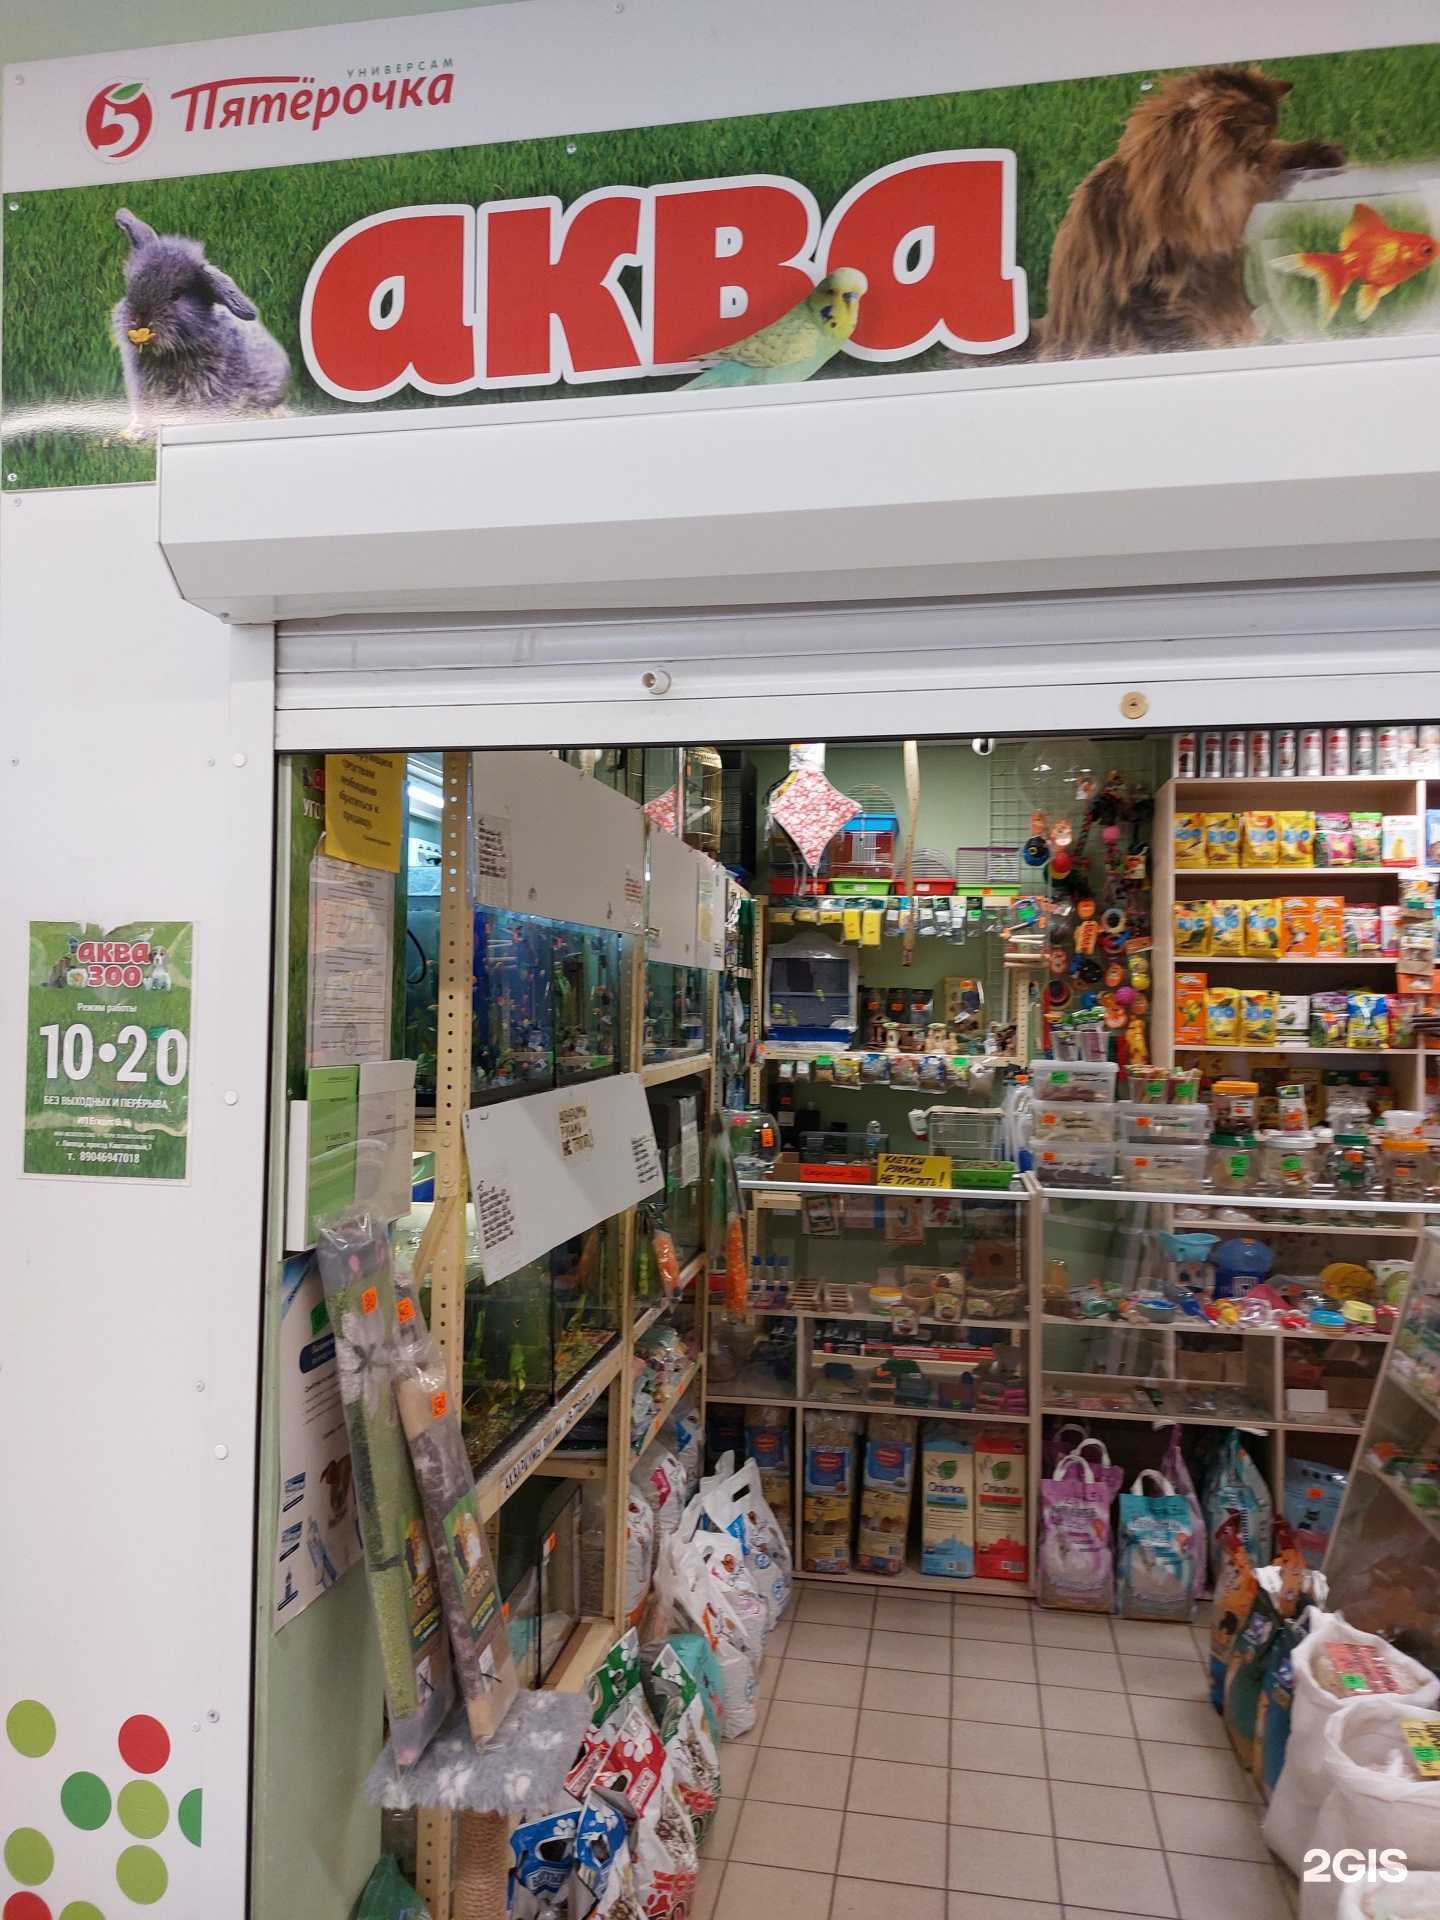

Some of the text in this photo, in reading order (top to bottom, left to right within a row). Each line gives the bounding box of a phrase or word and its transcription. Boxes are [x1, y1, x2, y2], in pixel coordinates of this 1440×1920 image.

[346, 58, 454, 79] УНИВЕРСАМ
[170, 73, 454, 132] Пятёрочка
[43, 1095, 60, 1105] БЕЗ
[61, 1096, 112, 1108] ВЫХОДНЫХ
[112, 1097, 120, 1107] И
